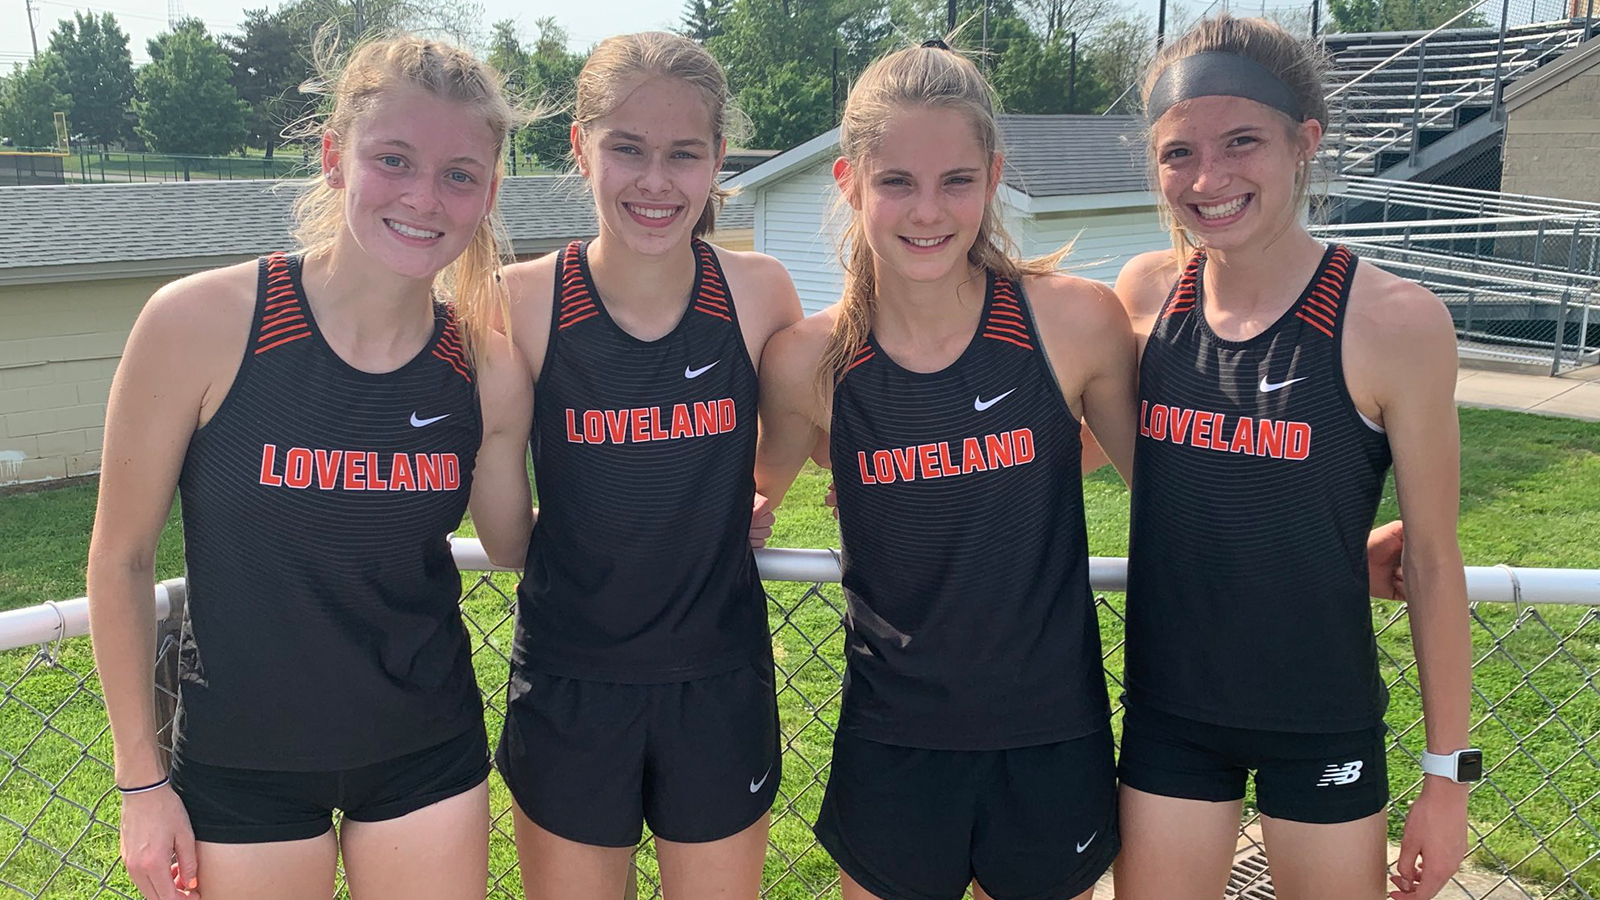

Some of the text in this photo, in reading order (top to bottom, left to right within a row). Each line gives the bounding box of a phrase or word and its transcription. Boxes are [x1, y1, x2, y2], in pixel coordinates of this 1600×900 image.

[565, 397, 737, 445] LOVELAND
[1140, 400, 1312, 461] LOVELAND
[260, 443, 460, 492] LOVELAND
[858, 427, 1036, 485] LOVELAND
